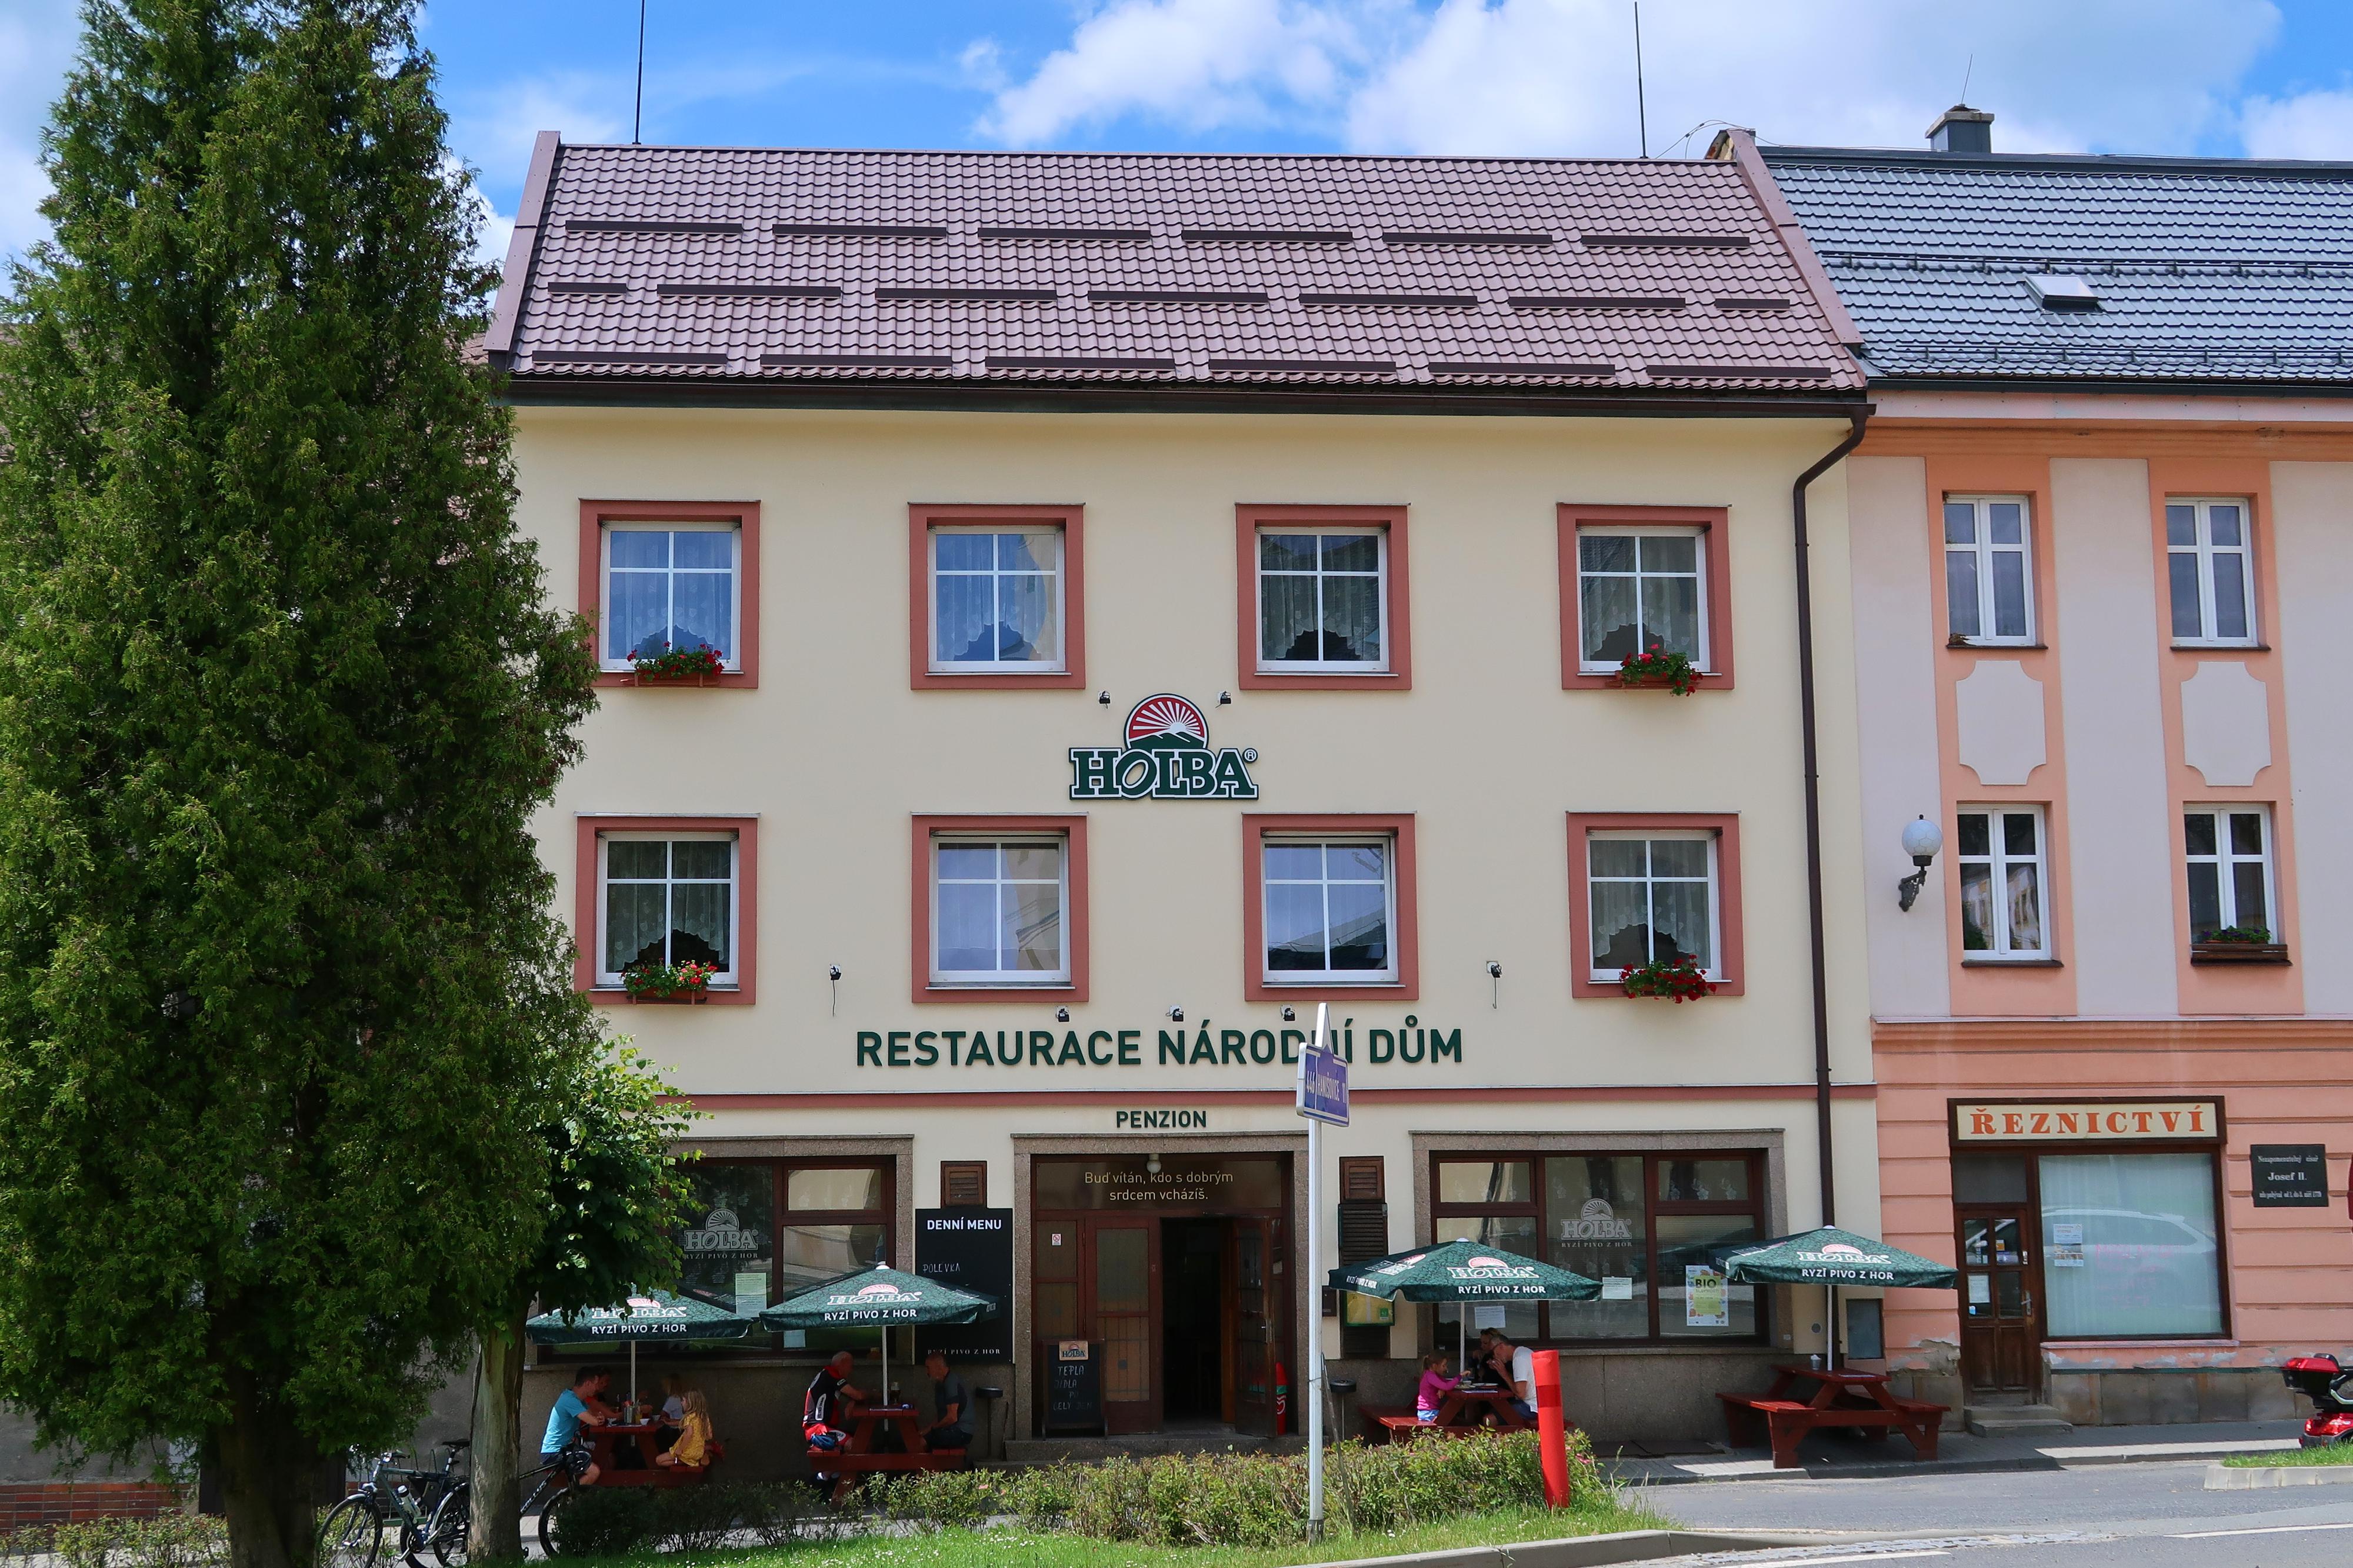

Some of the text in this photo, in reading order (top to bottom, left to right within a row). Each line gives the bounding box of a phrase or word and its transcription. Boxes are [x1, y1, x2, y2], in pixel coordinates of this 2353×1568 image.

[856, 1030, 1141, 1066] RESTAURACE
[1369, 1015, 1462, 1063] DŮM
[1116, 1110, 1207, 1128] PENZION
[1970, 1105, 2205, 1135] ŘEZNICTVÍ
[1085, 1170, 1234, 1185] Buď vítán, kdo s dobrým
[2268, 1172, 2307, 1180] Josef II.
[1109, 1188, 1208, 1200] srdcem vcházíš.
[927, 1217, 1002, 1230] DENNÍ MENU
[1561, 1219, 1632, 1240] HOLBA
[684, 1229, 758, 1252] HOLBA
[1797, 1250, 1892, 1265] HOLBA
[1447, 1266, 1540, 1279] HOLBA
[1801, 1267, 1894, 1280] RYZÍ PIVO Z HOR
[1458, 1285, 1546, 1294] RYZÍ PIVO Z HOR
[1695, 1279, 1717, 1289] BIO
[827, 1292, 922, 1306] HOLBA
[824, 1309, 917, 1321] RYZÍ PIVO Z HOR
[592, 1324, 687, 1334] RYZÍ PIVO Z HOR
